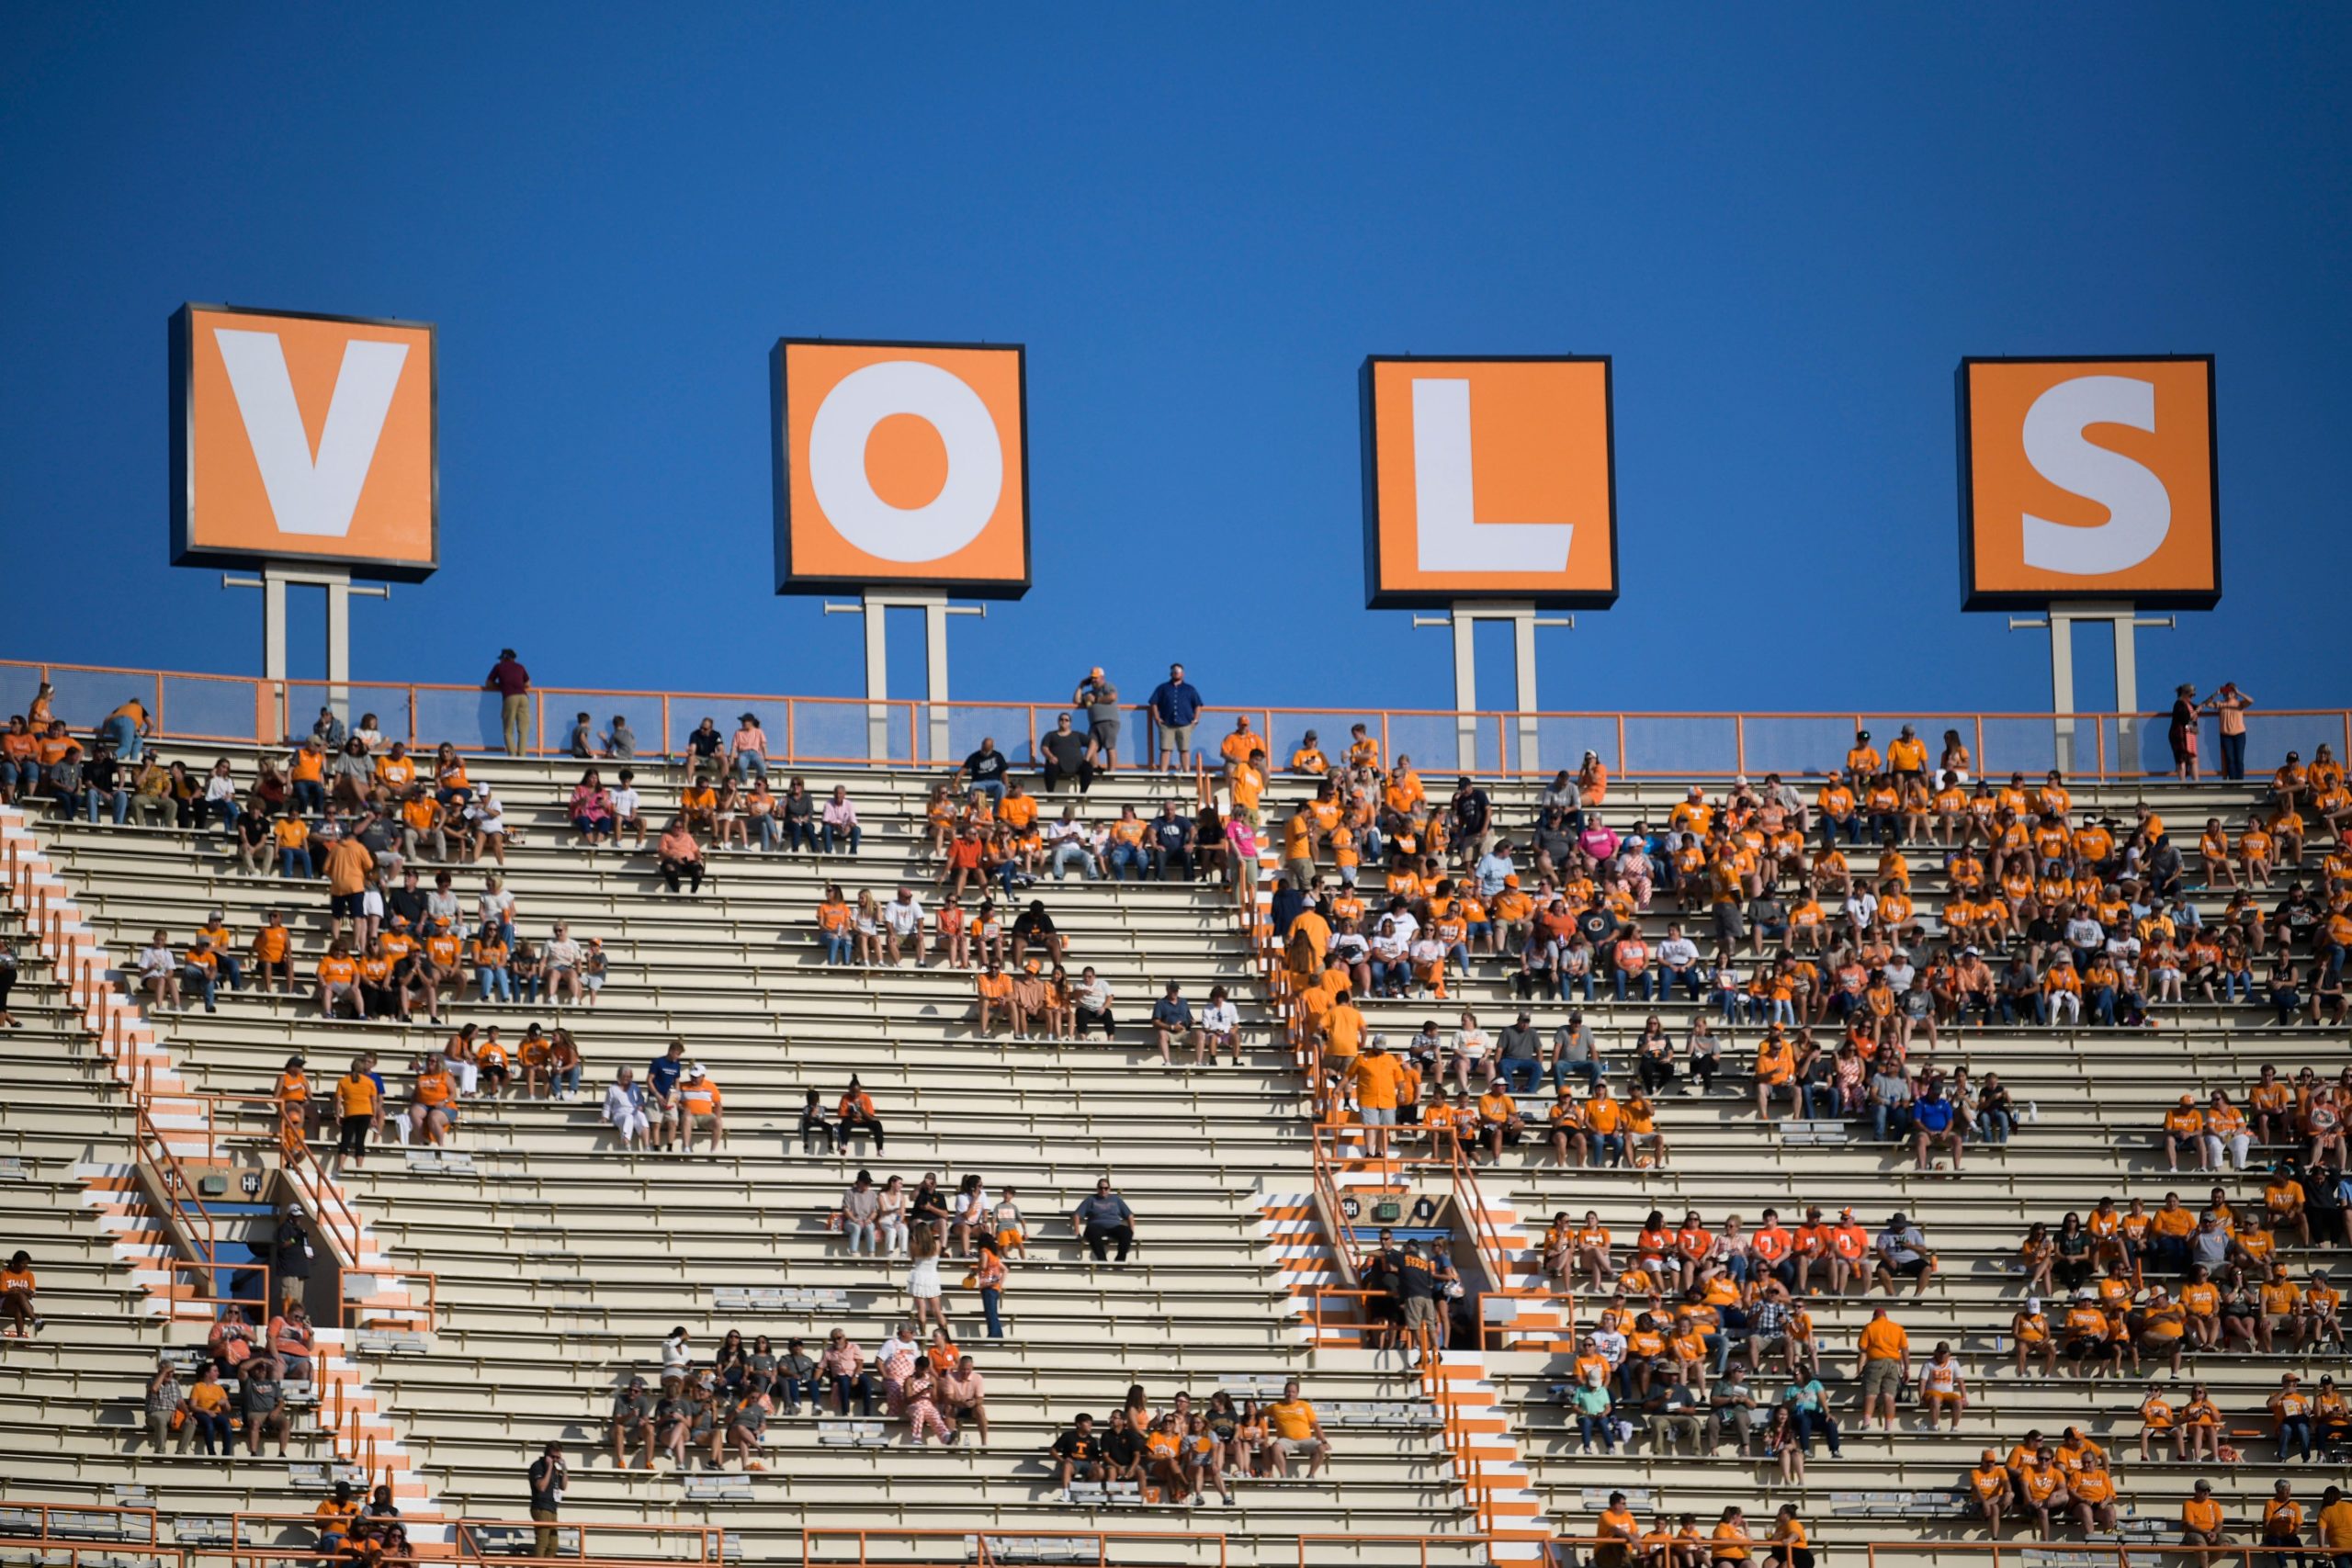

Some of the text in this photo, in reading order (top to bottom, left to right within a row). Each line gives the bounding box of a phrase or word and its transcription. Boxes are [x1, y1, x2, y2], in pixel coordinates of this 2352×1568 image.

[215, 330, 409, 536] V
[809, 362, 1002, 562] O
[1412, 379, 1573, 571] L
[2023, 377, 2170, 573] S
[1076, 1442, 1088, 1453] T
